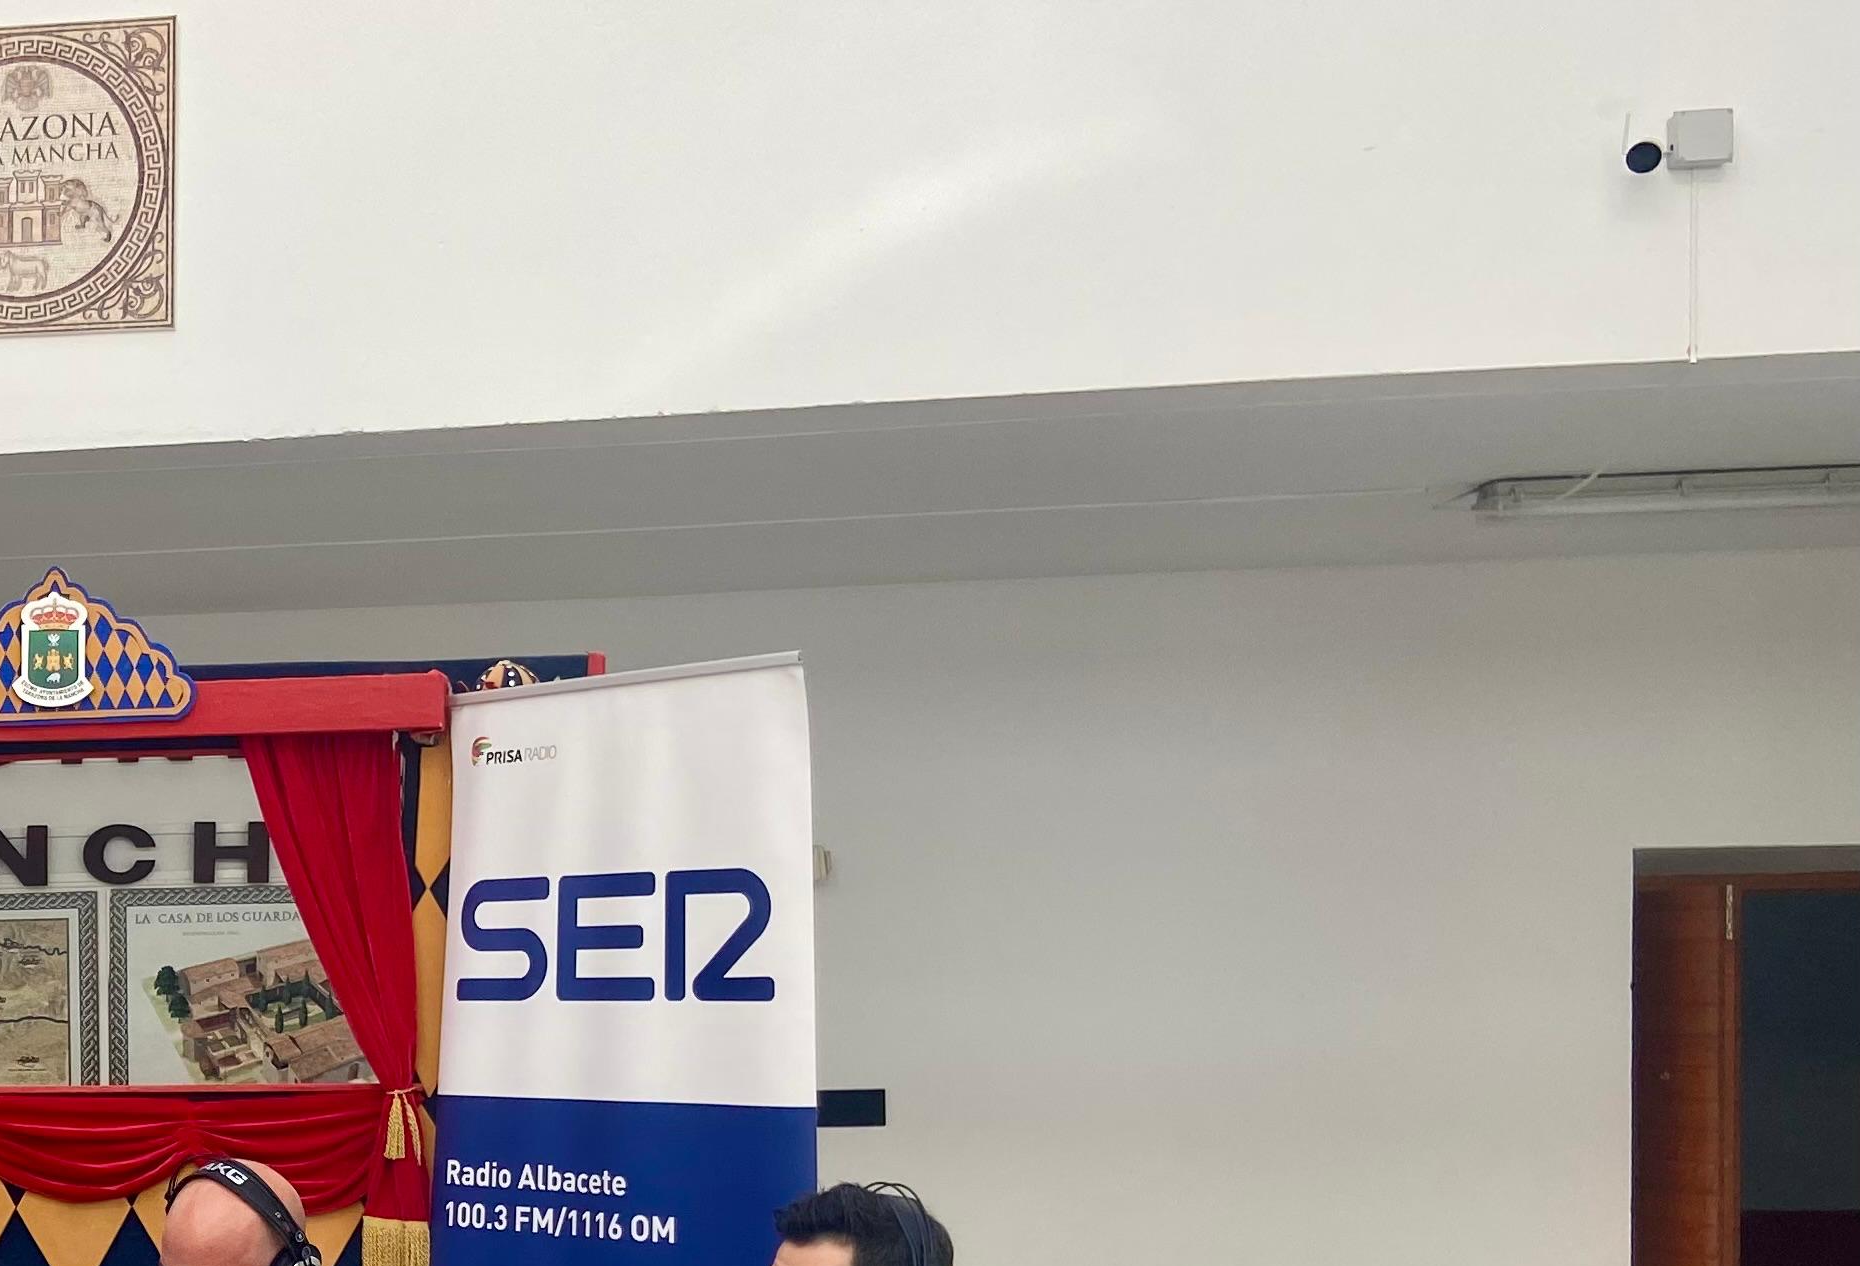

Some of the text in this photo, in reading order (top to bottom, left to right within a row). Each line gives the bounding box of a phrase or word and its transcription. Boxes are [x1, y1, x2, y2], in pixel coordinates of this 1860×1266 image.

[11, 142, 120, 165] MANCHA
[486, 745, 557, 765] PRISA RADIO
[135, 913, 151, 924] LA
[158, 913, 191, 924] CASA
[196, 913, 213, 923] DE
[217, 912, 240, 923] LOS
[456, 867, 775, 1002] SER
[200, 1162, 249, 1185] AKG
[446, 1159, 627, 1196] Radio Albacete
[445, 1201, 676, 1244] 100.3 FM/1116 OM
